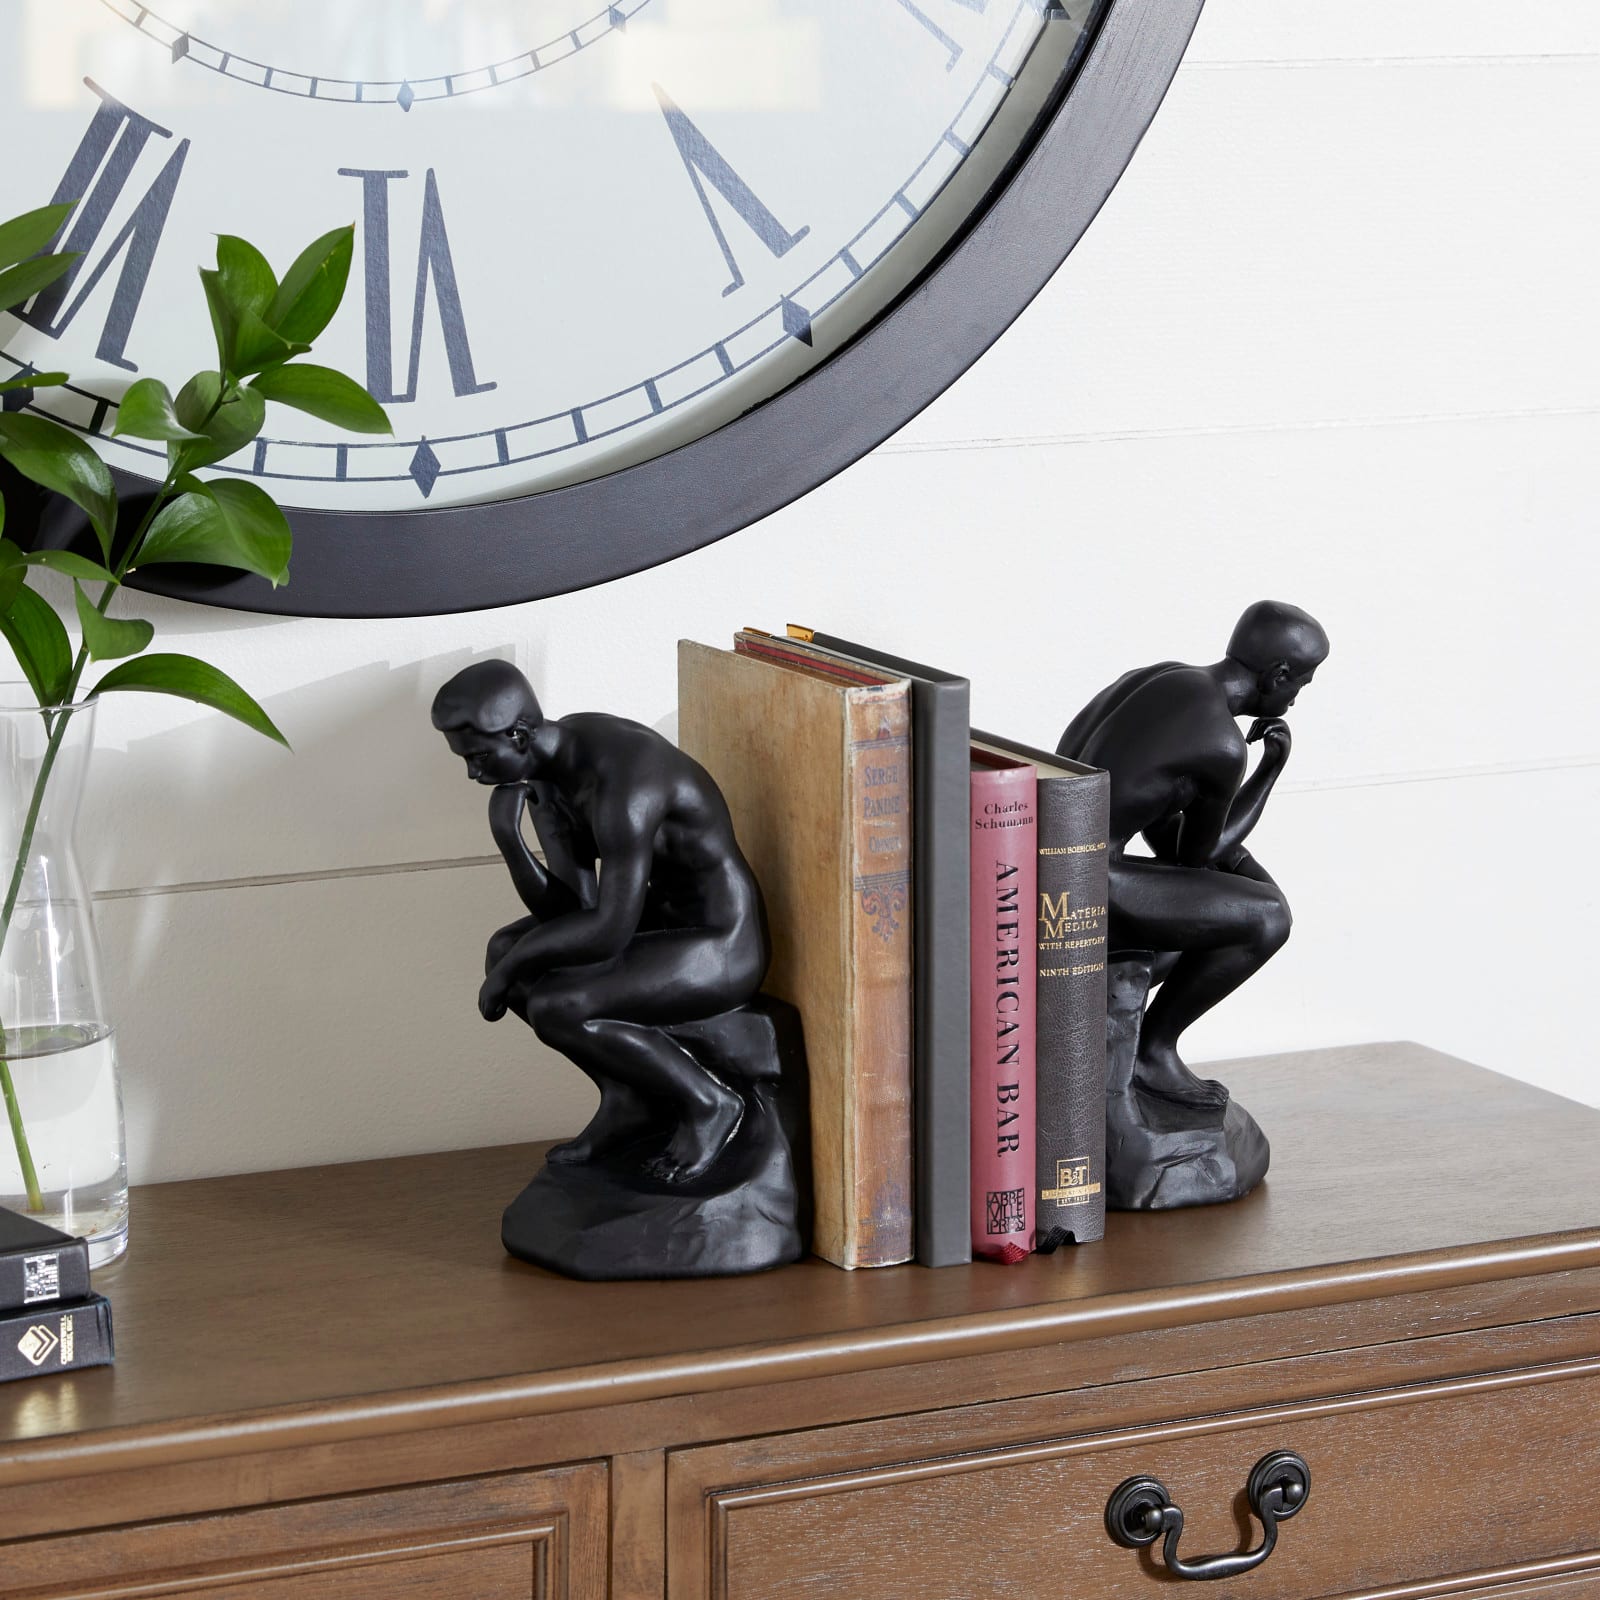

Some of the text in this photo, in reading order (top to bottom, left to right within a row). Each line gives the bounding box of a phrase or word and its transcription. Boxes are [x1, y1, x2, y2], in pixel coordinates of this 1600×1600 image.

[651, 80, 811, 298] V
[864, 765, 898, 788] SERGE
[984, 801, 1028, 815] Charles
[975, 816, 1034, 829] Schumann
[1039, 847, 1067, 855] WILLIAM
[1039, 891, 1107, 921] MATERIA
[1043, 919, 1099, 939] MEDICA
[1039, 936, 1106, 951] WITH REPERTORY
[1039, 962, 1104, 977] NINTH EDITION
[996, 860, 1020, 1158] AMERICAN BAR
[1060, 1165, 1088, 1187] B&T
